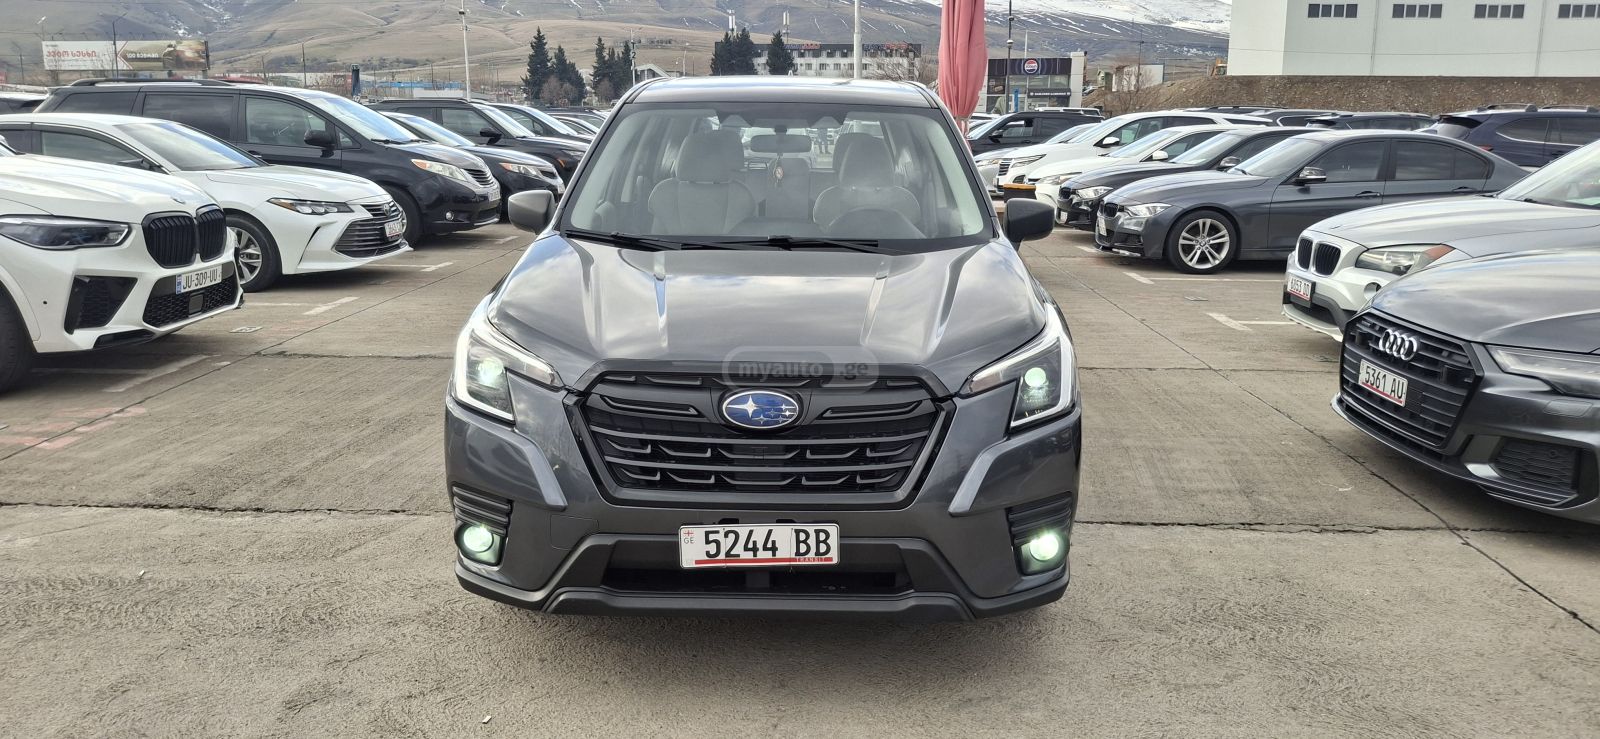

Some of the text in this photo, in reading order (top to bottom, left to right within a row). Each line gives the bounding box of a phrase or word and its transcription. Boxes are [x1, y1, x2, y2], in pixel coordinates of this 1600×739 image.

[182, 268, 218, 290] JU-309-UU
[1364, 365, 1405, 400] 5361 AU
[704, 528, 832, 559] 5244 BB
